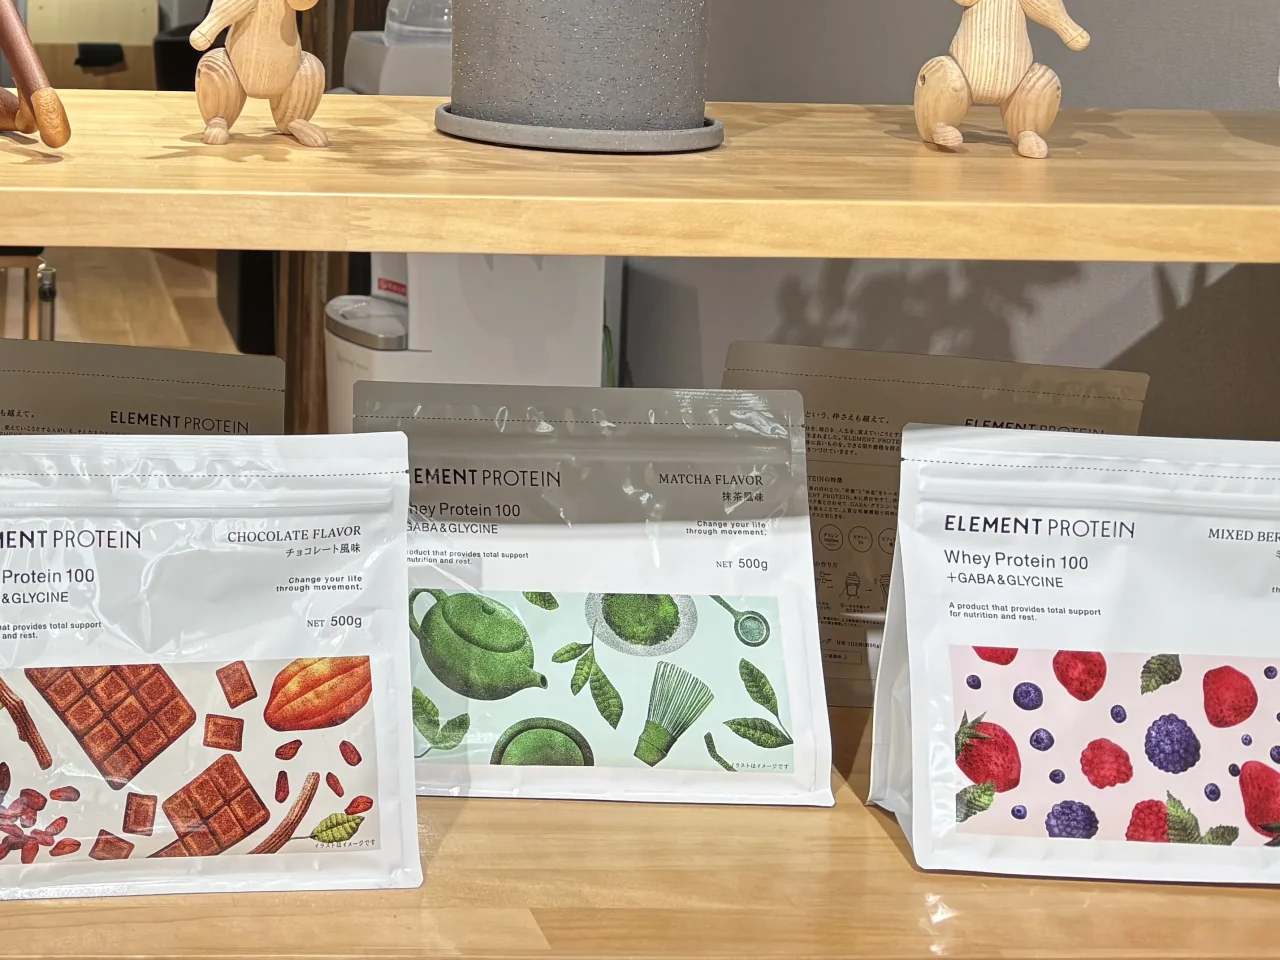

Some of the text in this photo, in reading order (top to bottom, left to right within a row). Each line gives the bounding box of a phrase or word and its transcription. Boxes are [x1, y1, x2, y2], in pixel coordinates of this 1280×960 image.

[110, 411, 249, 434] ELEMENT PROTEIN
[414, 468, 560, 487] EMENT PROTEIN
[659, 473, 763, 486] MATCHA FLAVOR
[722, 491, 764, 502] 抹茶風味
[408, 502, 520, 517] hey Protein 100
[407, 522, 498, 534] GABA&GLYCINE
[697, 520, 727, 529] Change
[731, 521, 749, 529] your
[944, 514, 1135, 538] ELEMENT PROTEIN
[54, 529, 141, 548] PROTEIN
[227, 525, 361, 542] CHOCOLATE FLAVOR
[686, 528, 717, 536] through
[1208, 528, 1280, 543] MIXED BER
[285, 542, 361, 558] チョコレート風味
[716, 558, 768, 571] NET 500g
[944, 549, 1089, 570] Whey Protein 100
[2, 569, 62, 584] Protein
[66, 568, 95, 583] 100
[288, 576, 321, 584] Change
[957, 603, 989, 612] product
[991, 604, 1008, 612] that
[1011, 605, 1045, 615] provides
[1068, 608, 1101, 617] support
[963, 611, 998, 619] nutrition
[1000, 612, 1016, 620] and
[1018, 613, 1037, 621] rest.
[13, 623, 47, 632] provides
[49, 622, 68, 630] total
[70, 621, 102, 630] support
[330, 615, 362, 628] 500g
[731, 762, 789, 770] イラストはイメージです
[315, 839, 375, 849] イラストはイメージです
